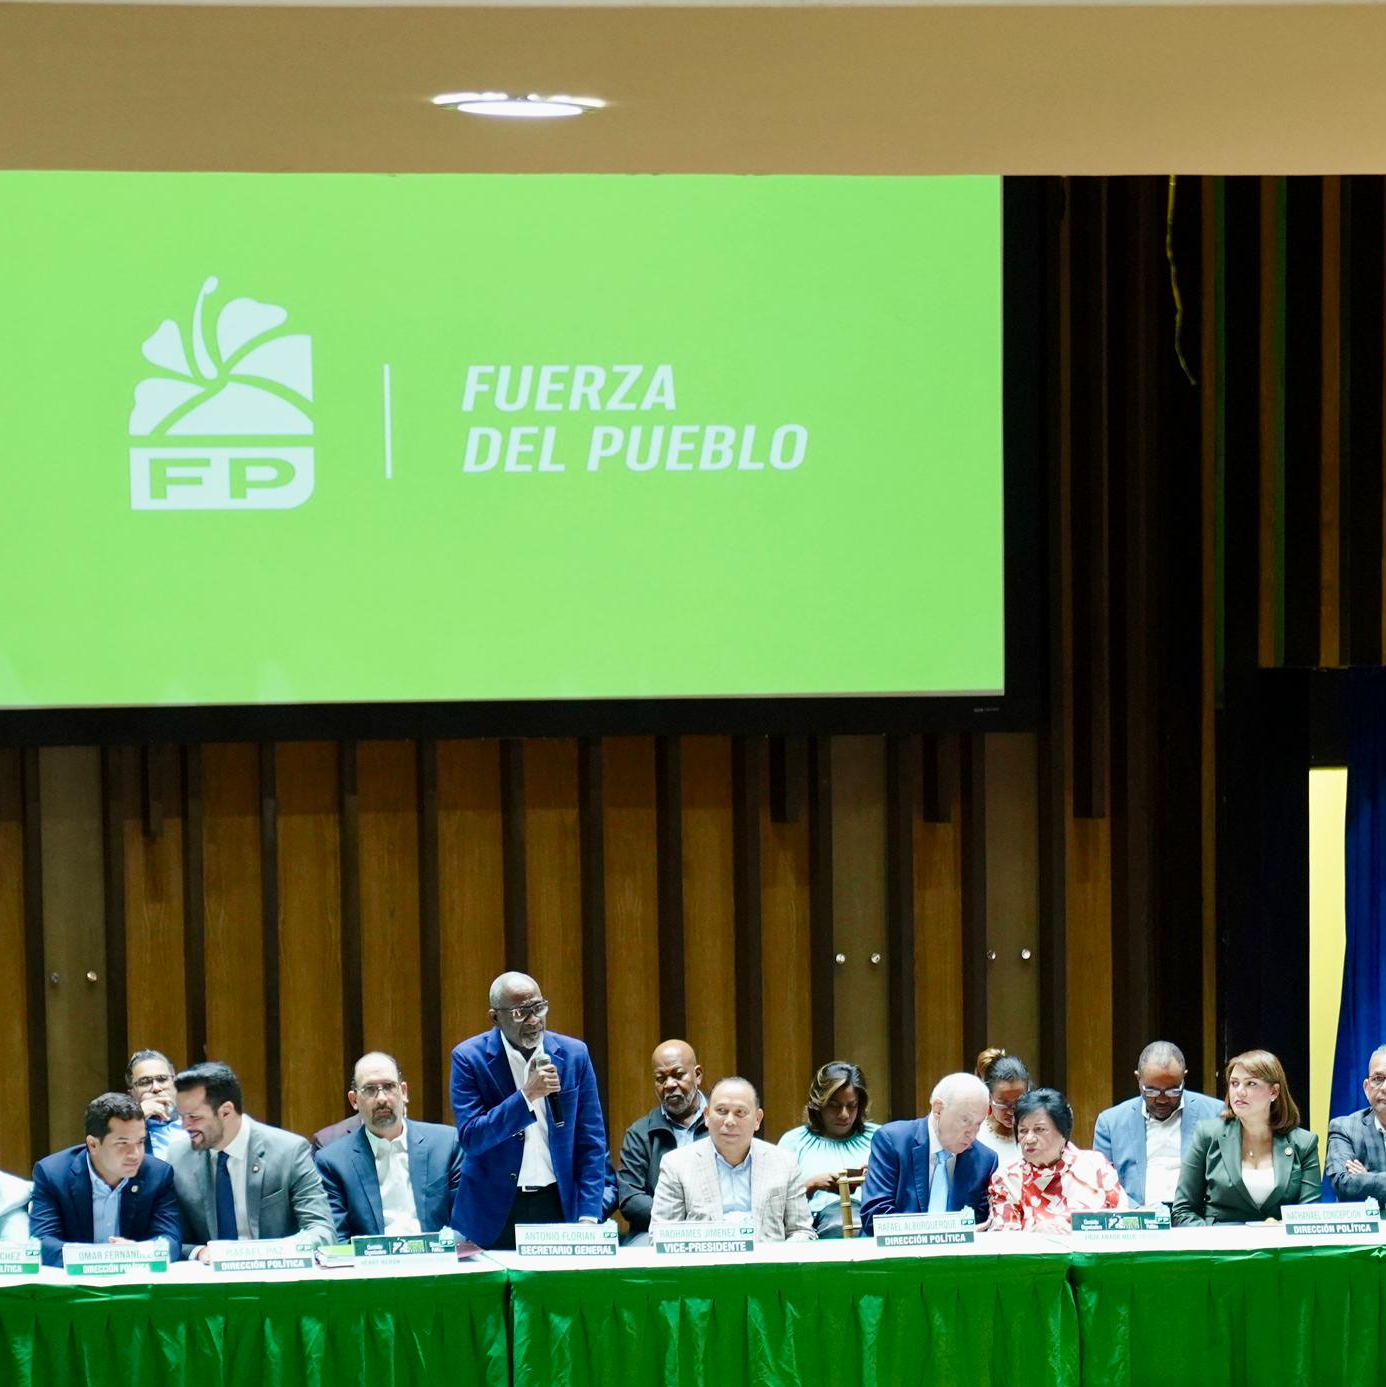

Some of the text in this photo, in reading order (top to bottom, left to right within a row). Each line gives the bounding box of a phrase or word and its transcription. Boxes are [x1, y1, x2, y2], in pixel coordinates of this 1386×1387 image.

[461, 364, 676, 412] FUERZA
[463, 423, 808, 473] DEL PUEBLO
[147, 456, 296, 500] FP
[1292, 1222, 1372, 1234] DIRECCIÓN POLÍTICA
[524, 1231, 596, 1241] ANTONIO FLORIAN
[884, 1233, 966, 1246] DIRECCIÓN POLÍTICA
[520, 1245, 614, 1255] SECRETARIO GENERAL
[664, 1241, 746, 1253] VICE-PRESIDENTE
[78, 1250, 102, 1260] OMAR
[221, 1258, 305, 1271] DIRECCIÓN POLÍTICA
